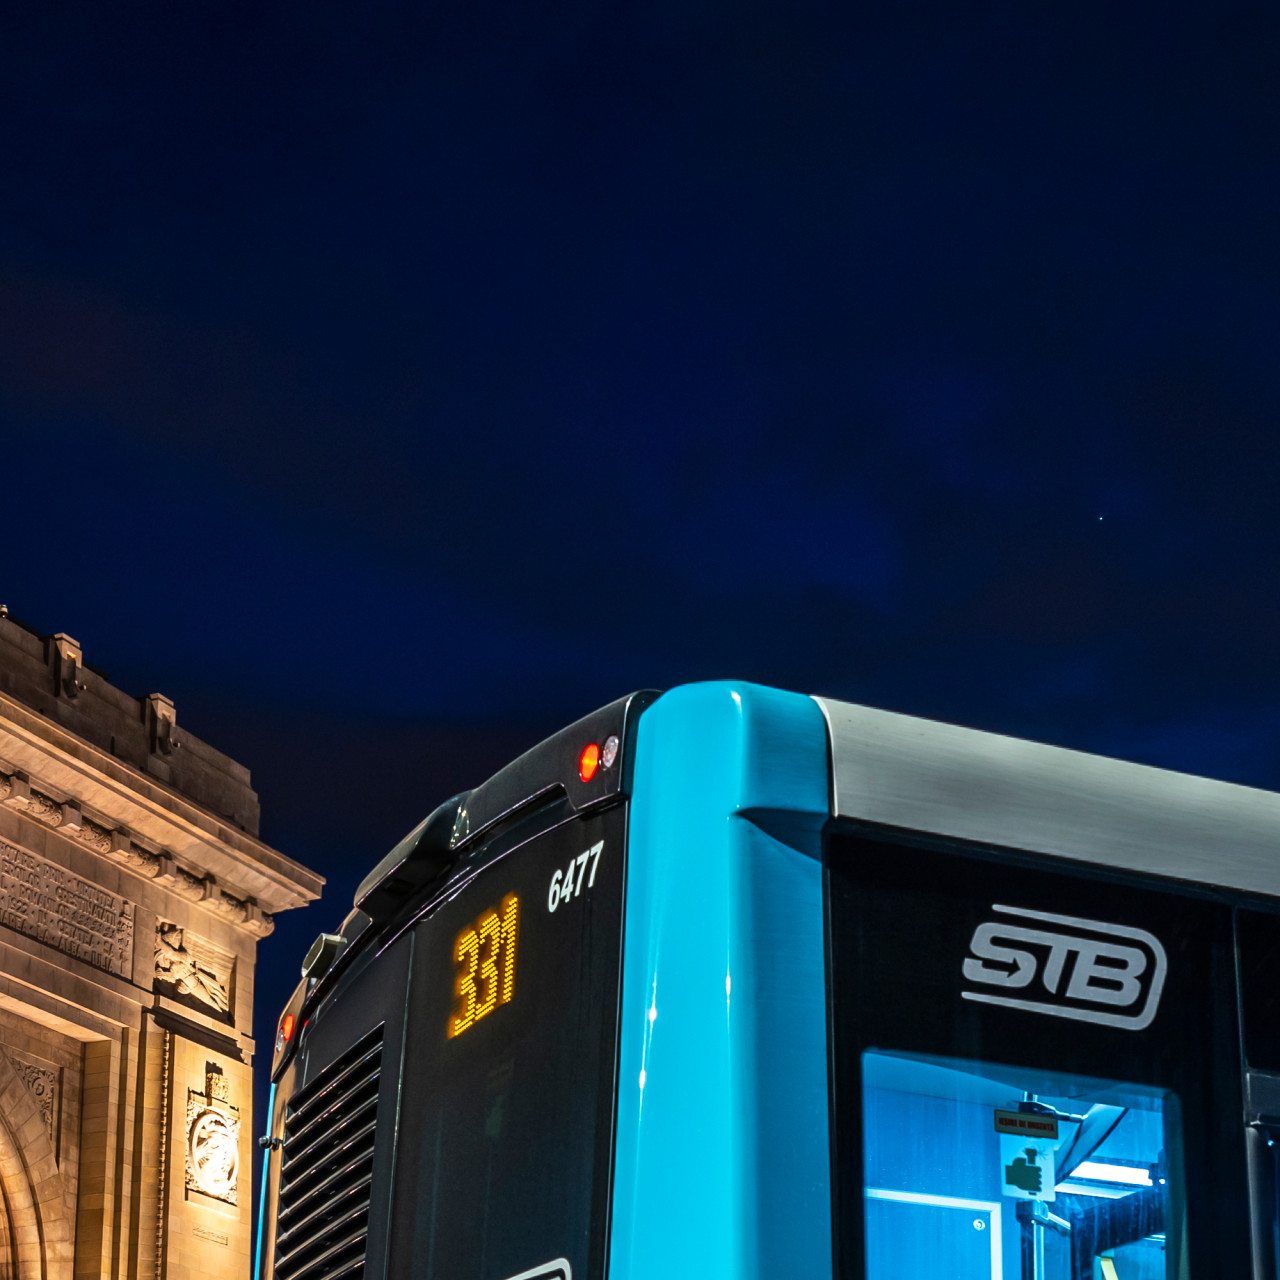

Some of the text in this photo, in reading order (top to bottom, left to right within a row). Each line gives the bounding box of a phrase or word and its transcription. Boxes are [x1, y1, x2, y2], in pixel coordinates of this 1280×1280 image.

[548, 839, 605, 913] 6477
[453, 894, 519, 1038] 331
[961, 922, 1148, 1007] STB
